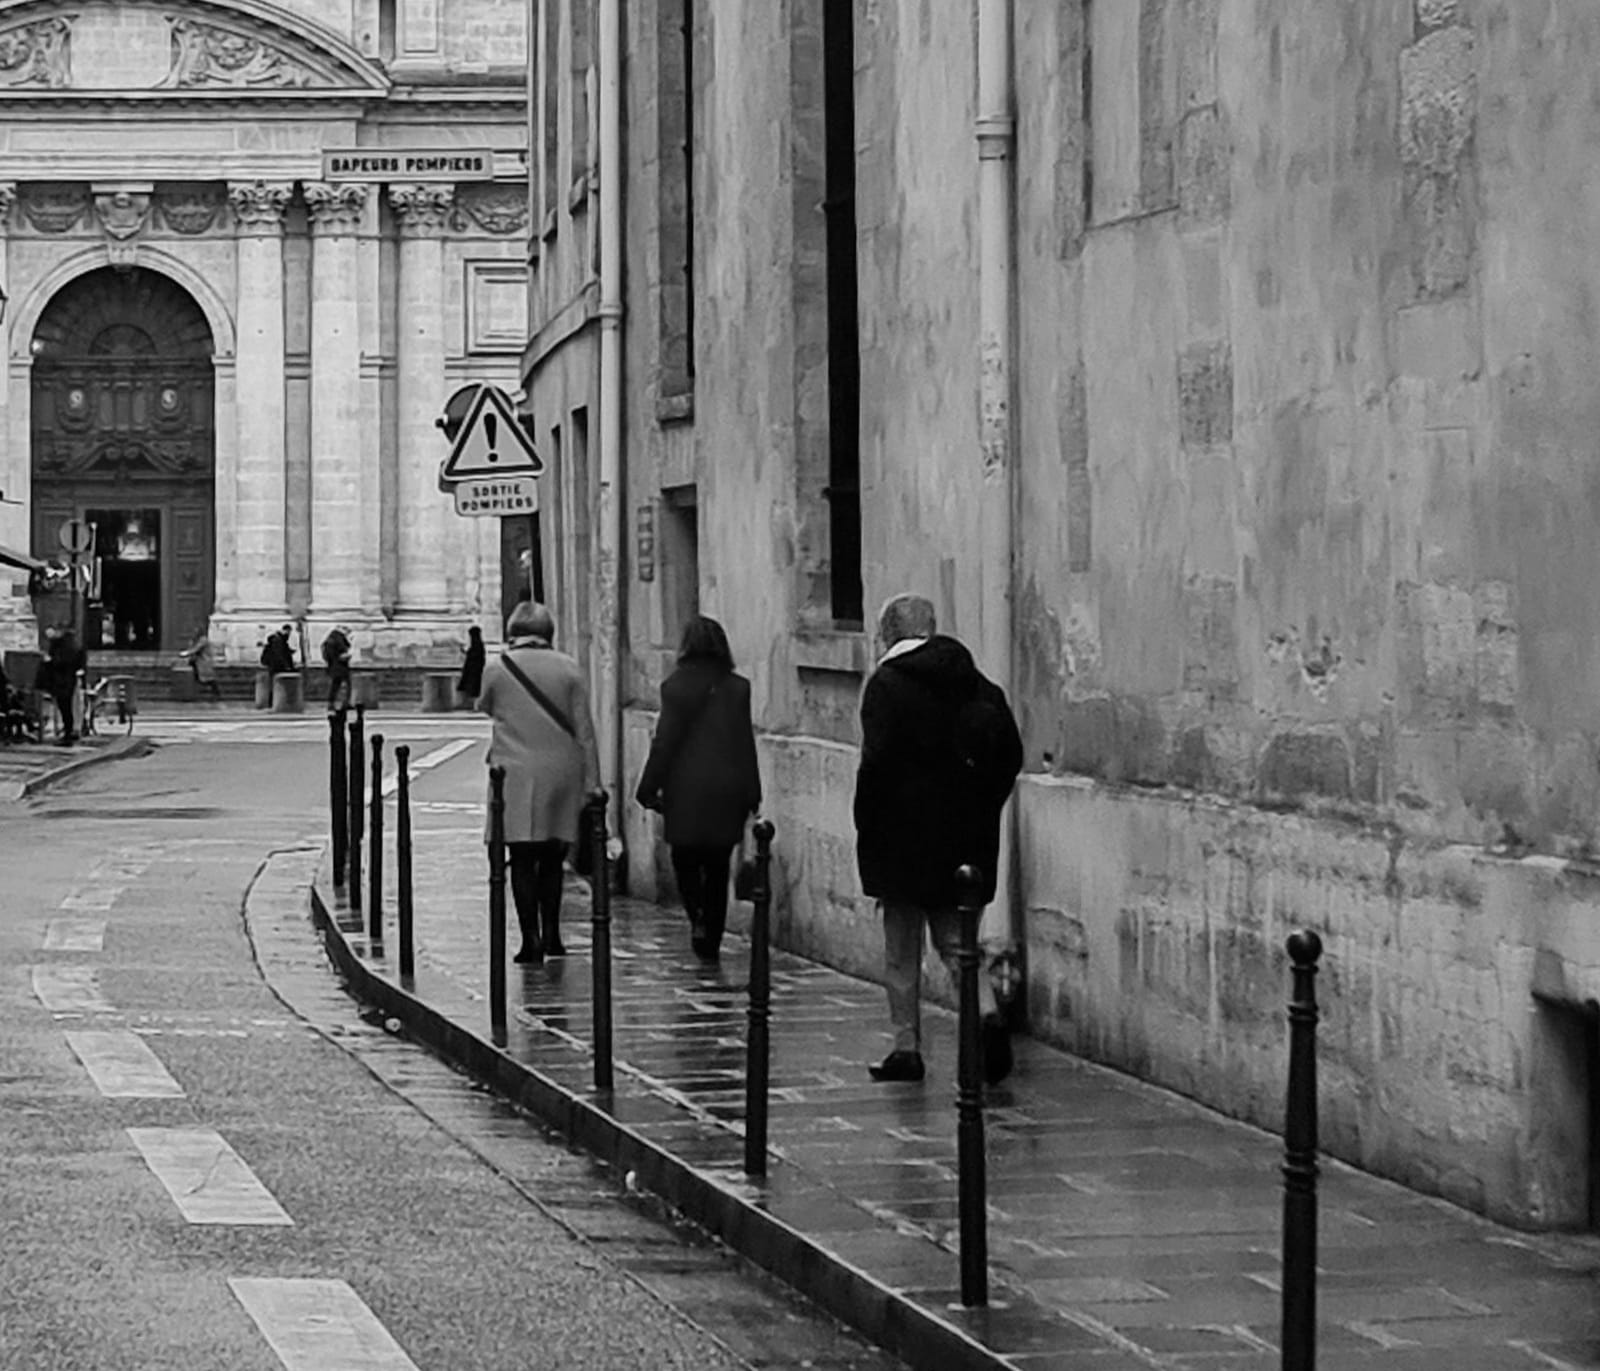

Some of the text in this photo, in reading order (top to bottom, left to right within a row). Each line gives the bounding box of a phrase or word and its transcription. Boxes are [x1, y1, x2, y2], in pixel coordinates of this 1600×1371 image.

[331, 157, 482, 172] SAPEURS POMPIERS
[473, 483, 521, 498] SORTIE
[461, 496, 533, 512] POMPIERS
